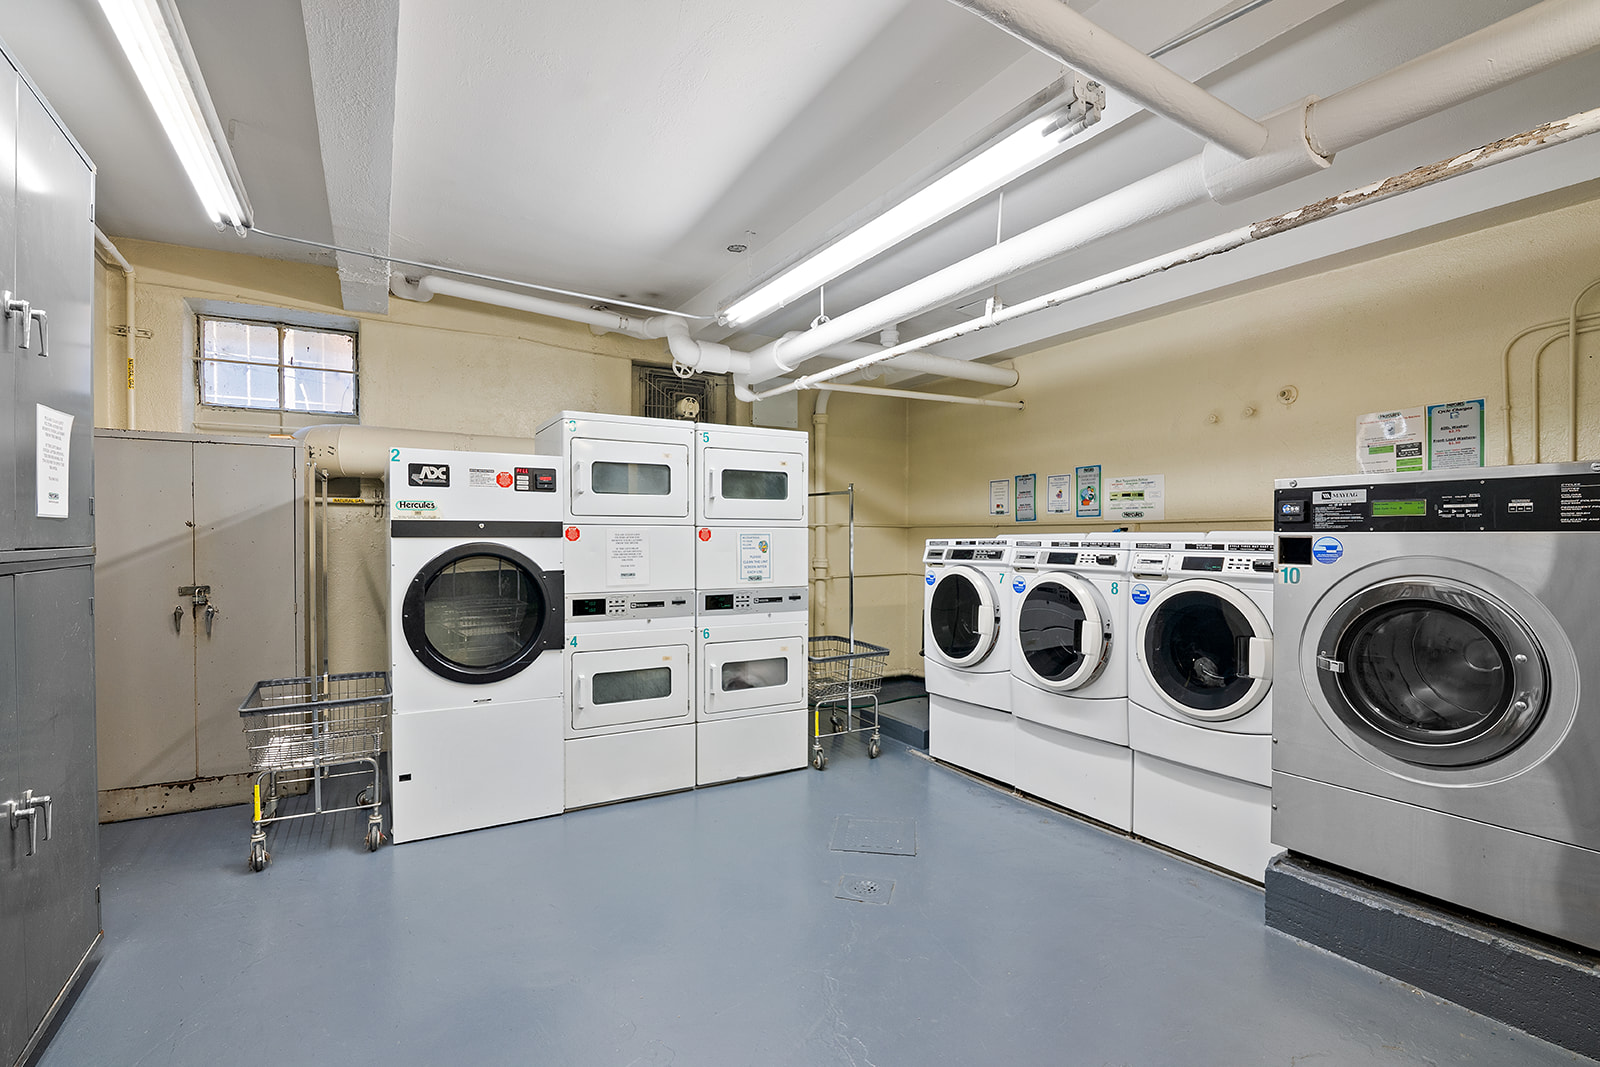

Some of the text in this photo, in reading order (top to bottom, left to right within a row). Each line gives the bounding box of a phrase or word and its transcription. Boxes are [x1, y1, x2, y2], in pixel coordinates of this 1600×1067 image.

[703, 432, 710, 444] 5
[391, 448, 400, 462] 2
[420, 466, 447, 480] ADC
[399, 501, 436, 509] Hercules
[998, 573, 1004, 584] 7
[1280, 567, 1300, 584] 10
[1111, 582, 1119, 595] 8
[703, 628, 710, 640] 6
[570, 636, 578, 648] 4
